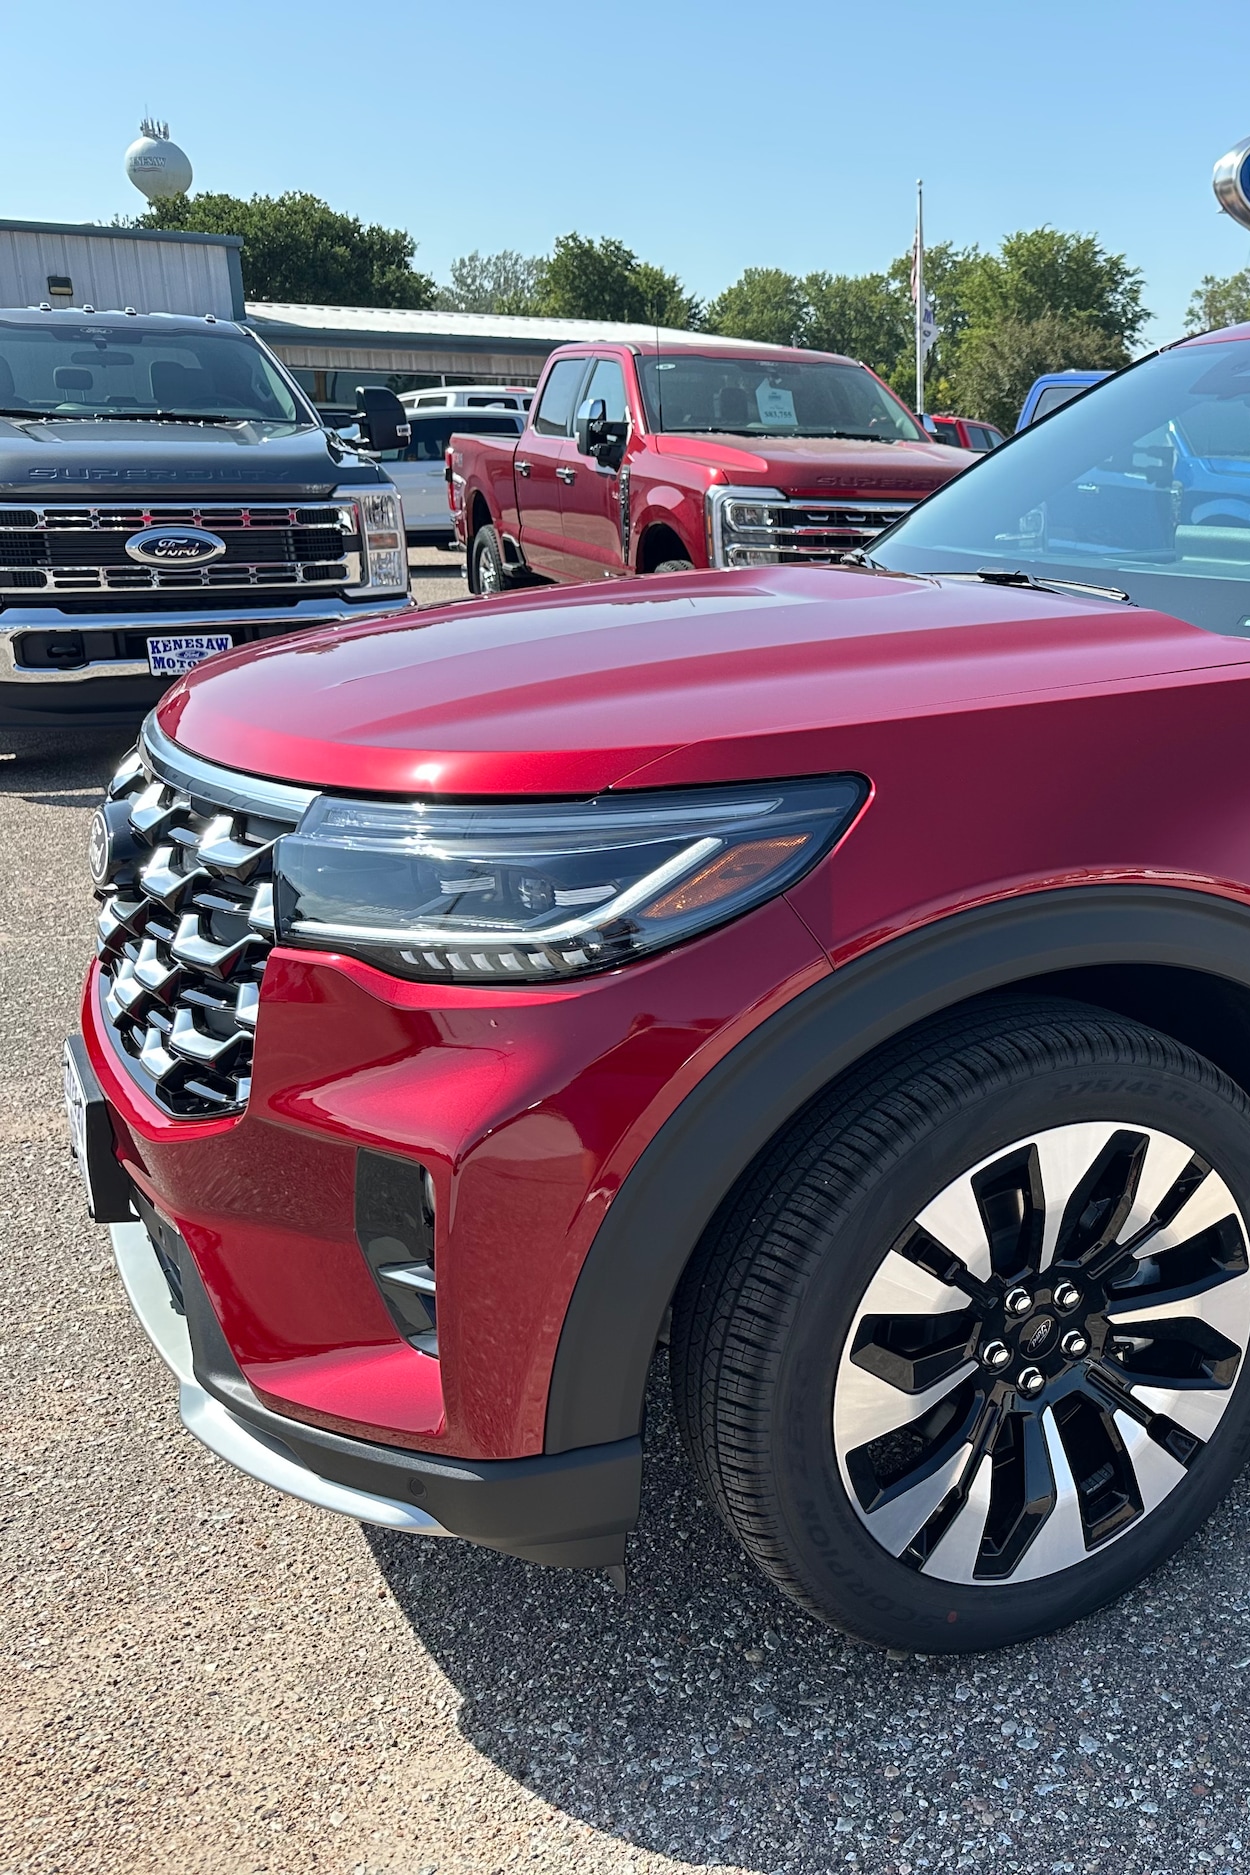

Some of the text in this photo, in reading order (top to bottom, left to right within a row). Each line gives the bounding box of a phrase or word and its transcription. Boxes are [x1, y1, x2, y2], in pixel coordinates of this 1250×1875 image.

[29, 467, 290, 480] SUPER DUTY
[816, 475, 914, 489] SUPER
[154, 538, 200, 556] Ford
[149, 637, 229, 655] KENESAW
[152, 656, 200, 669] MOTO
[1053, 1078, 1163, 1100] 275/45
